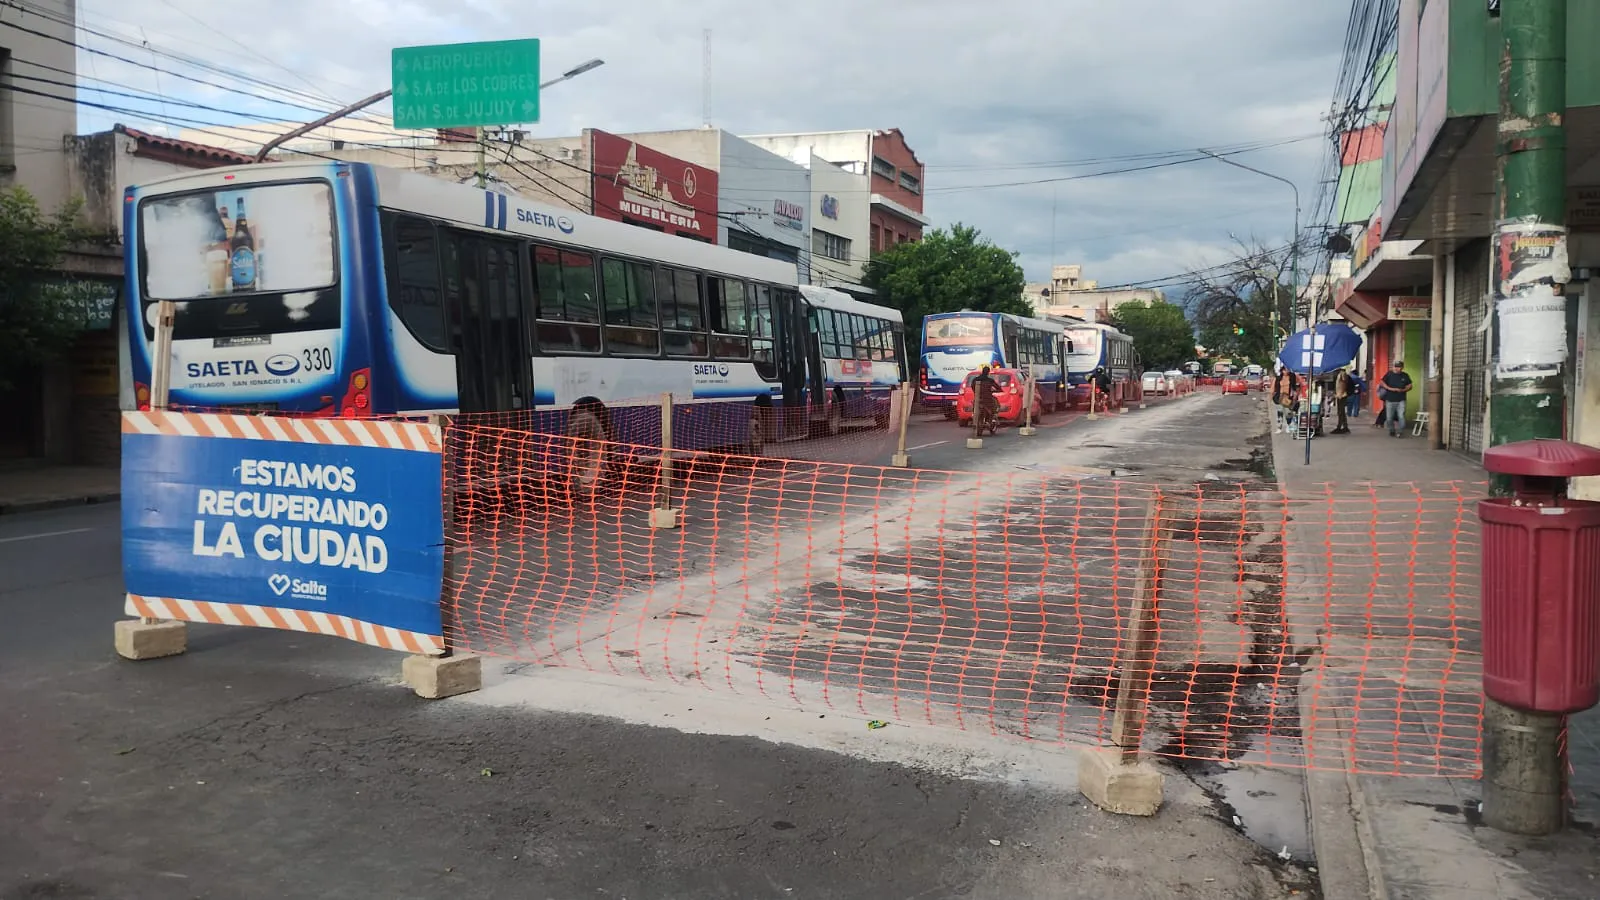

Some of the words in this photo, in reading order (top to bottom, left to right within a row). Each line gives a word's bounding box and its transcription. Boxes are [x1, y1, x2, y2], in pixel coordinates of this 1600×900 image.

[412, 49, 513, 72] AEROPUERTO
[453, 77, 478, 93] LOS
[482, 73, 535, 92] COBRES
[397, 105, 427, 121] SAN
[446, 105, 459, 119] DE
[464, 99, 516, 119] JUJUY
[516, 208, 557, 229] SAETA
[619, 200, 701, 231] MUEBLERIA
[187, 359, 260, 378] SAETA
[303, 347, 332, 372] 330
[694, 364, 718, 375] SAETA
[240, 459, 357, 492] ESTAMOS
[197, 489, 388, 531] RECUPERANDO
[192, 519, 245, 558] LA
[253, 524, 389, 573] CIUDAD
[291, 578, 328, 596] Salta
